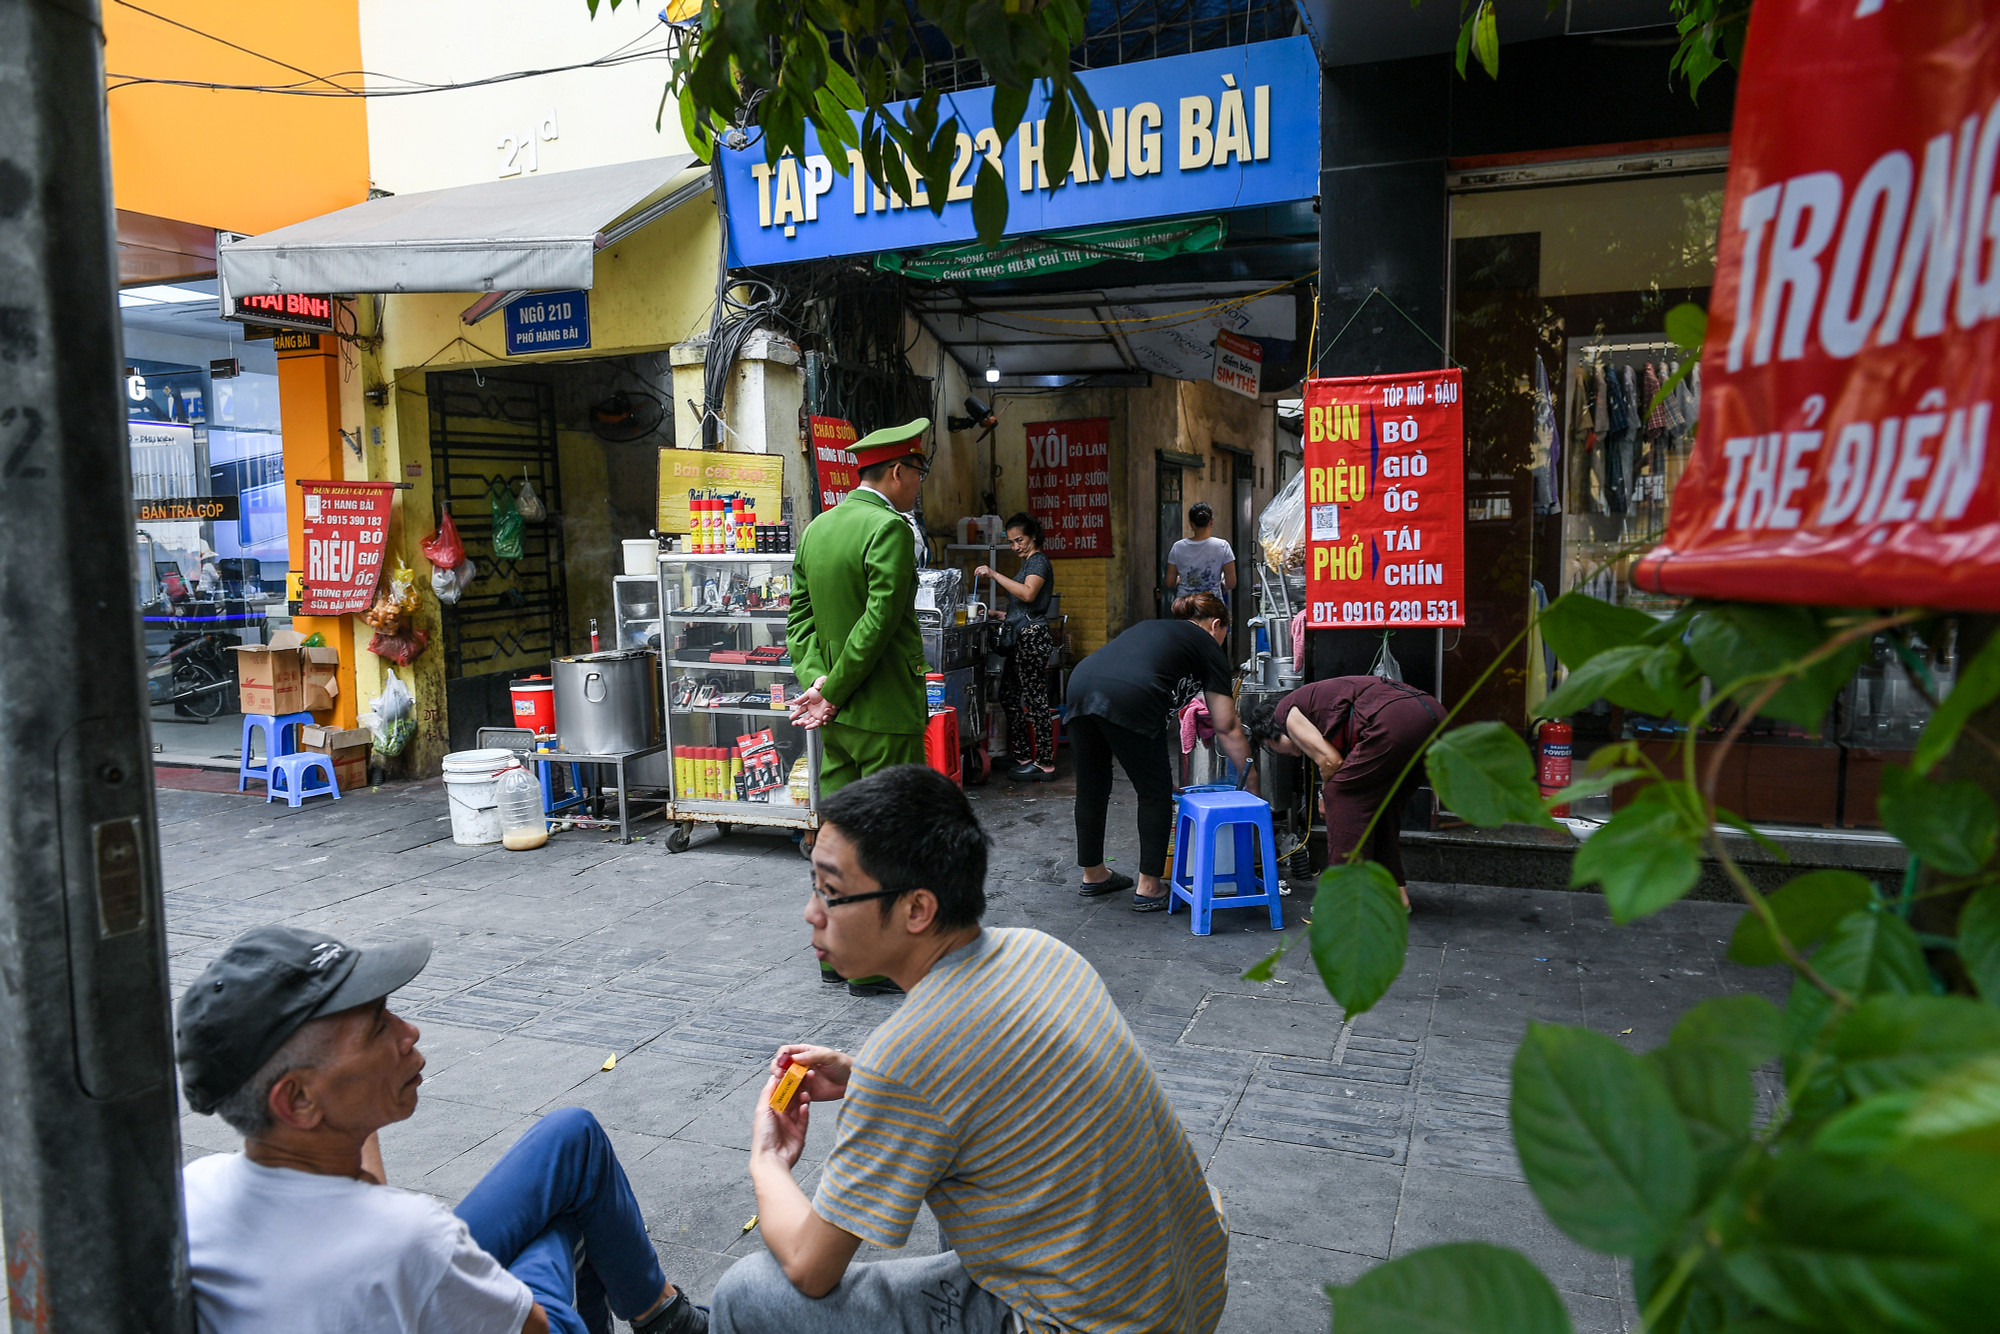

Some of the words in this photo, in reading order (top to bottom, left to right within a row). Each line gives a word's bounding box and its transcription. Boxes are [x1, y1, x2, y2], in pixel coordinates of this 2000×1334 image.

[752, 144, 833, 237] TẬP
[1179, 73, 1270, 171] BÀI
[986, 244, 1022, 260] CNG
[519, 302, 546, 325] NGÕ
[548, 301, 572, 322] 21D
[274, 333, 296, 349] HÀNG
[297, 332, 311, 348] BÀI
[516, 328, 534, 345] PHỐ
[536, 327, 561, 343] HÀNG
[563, 325, 579, 340] BÀI
[1216, 365, 1235, 387] SIM
[1434, 379, 1458, 408] ĐẬU
[813, 421, 836, 438] CHÁO
[1309, 398, 1360, 443] BÚN
[1382, 415, 1419, 443] BÒ
[1029, 427, 1069, 470] XÔI
[1068, 443, 1084, 457] CÔ
[1085, 442, 1108, 457] LAN
[674, 461, 700, 478] Bán
[704, 463, 731, 479] các
[1382, 449, 1428, 478] GIÒ
[1713, 393, 1824, 531] THẺ
[1816, 387, 1993, 545] ĐIỆN
[1309, 458, 1366, 503] RIÊU
[141, 502, 167, 520] BÁN
[169, 501, 194, 519] TRẢ
[197, 500, 225, 518] GÓP
[321, 500, 332, 510] 21
[1068, 494, 1087, 511] THỊT
[1089, 492, 1108, 507] KHO
[1382, 483, 1419, 513] ỐC
[326, 515, 348, 525] 0915
[349, 516, 365, 526] 390
[367, 516, 382, 526] 183
[1061, 512, 1080, 529] XÚC
[1081, 511, 1104, 528] XÍCH
[1074, 533, 1098, 550] PATÊ
[1382, 525, 1422, 552] TÁI
[309, 530, 356, 583] RIÊU
[1313, 534, 1365, 581] PHỞ
[1383, 559, 1443, 586] CHÍN
[1312, 601, 1338, 623] ĐT:
[1341, 601, 1385, 622] 0916
[1389, 600, 1426, 622] 280
[1427, 599, 1458, 621] 531
